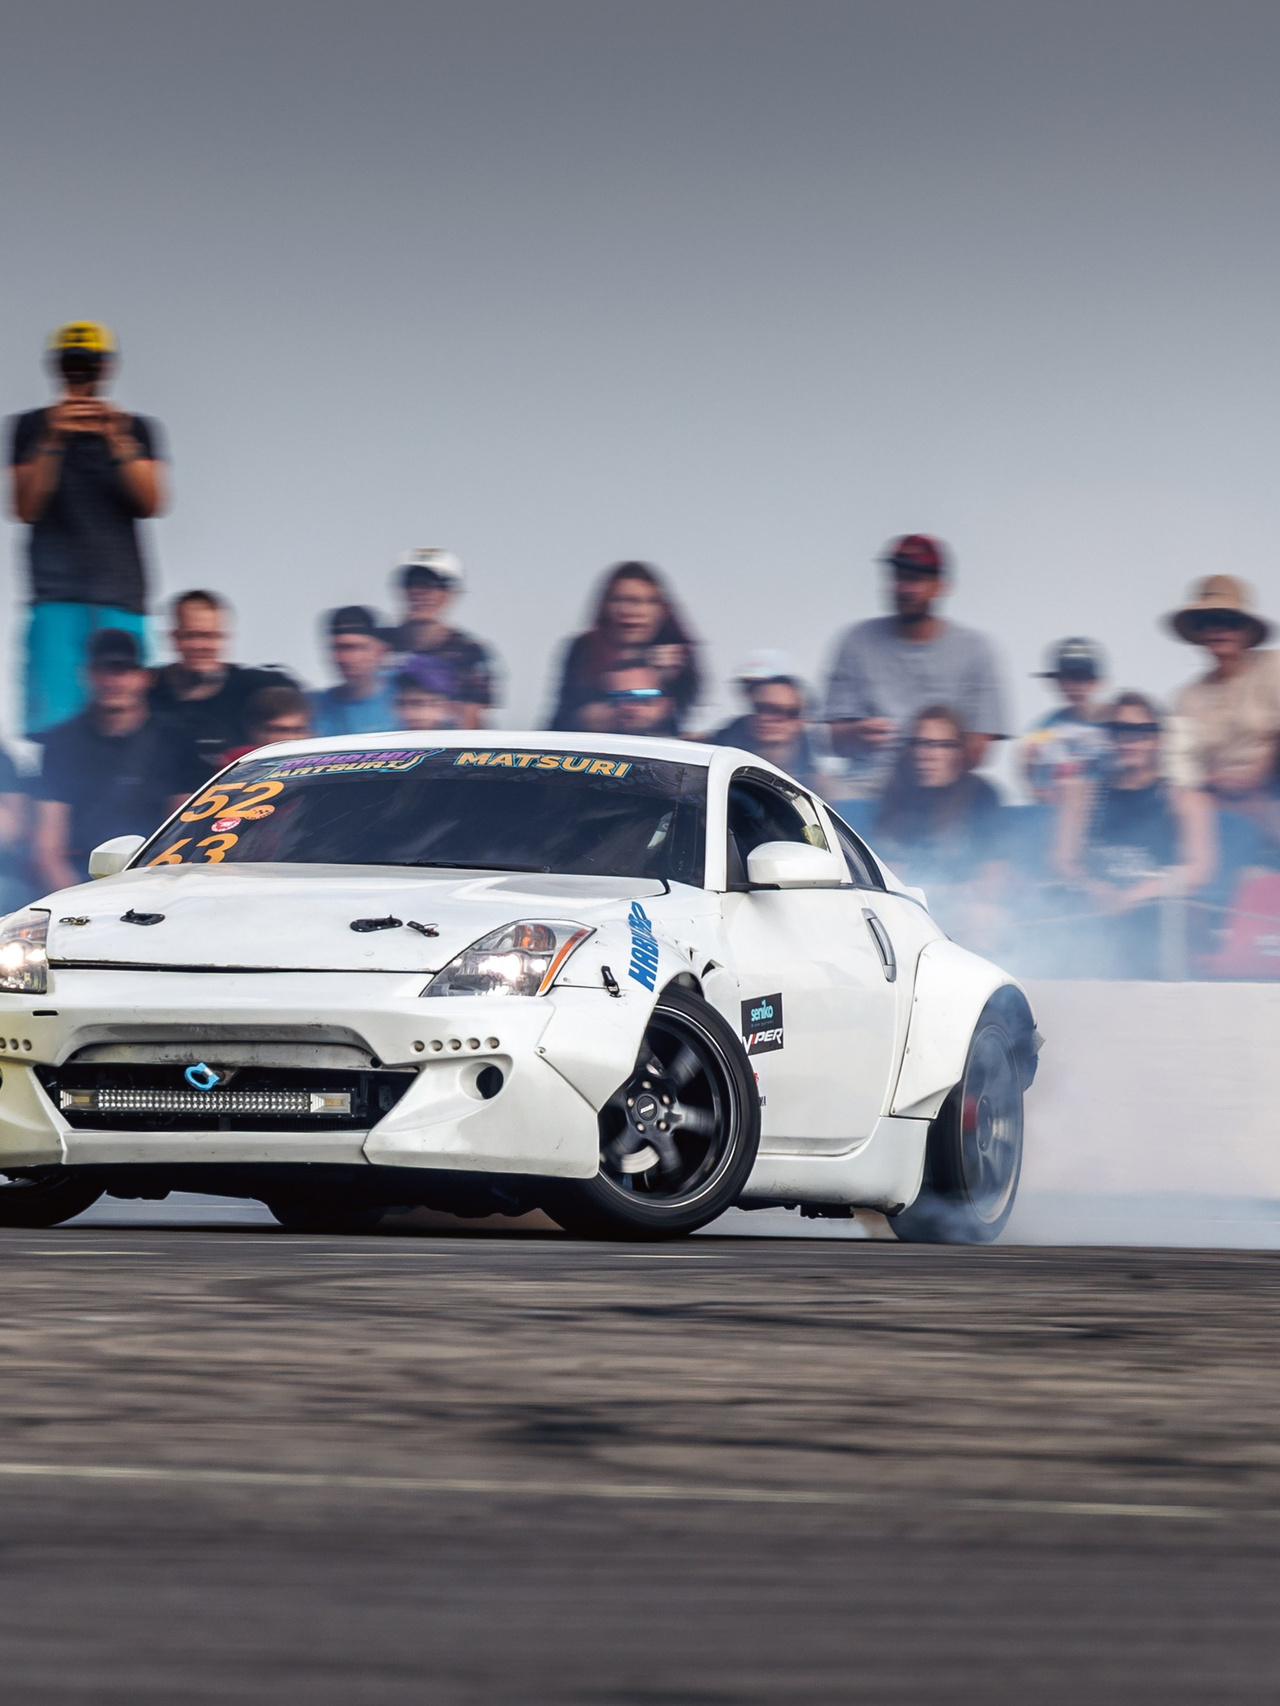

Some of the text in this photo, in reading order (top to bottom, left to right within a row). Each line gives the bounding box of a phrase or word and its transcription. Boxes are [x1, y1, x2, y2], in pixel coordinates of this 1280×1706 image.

[264, 761, 405, 779] MATSURI
[455, 750, 632, 779] MATSURI
[180, 781, 284, 822] 52
[146, 833, 239, 867] 63
[742, 1028, 783, 1055] VIPER
